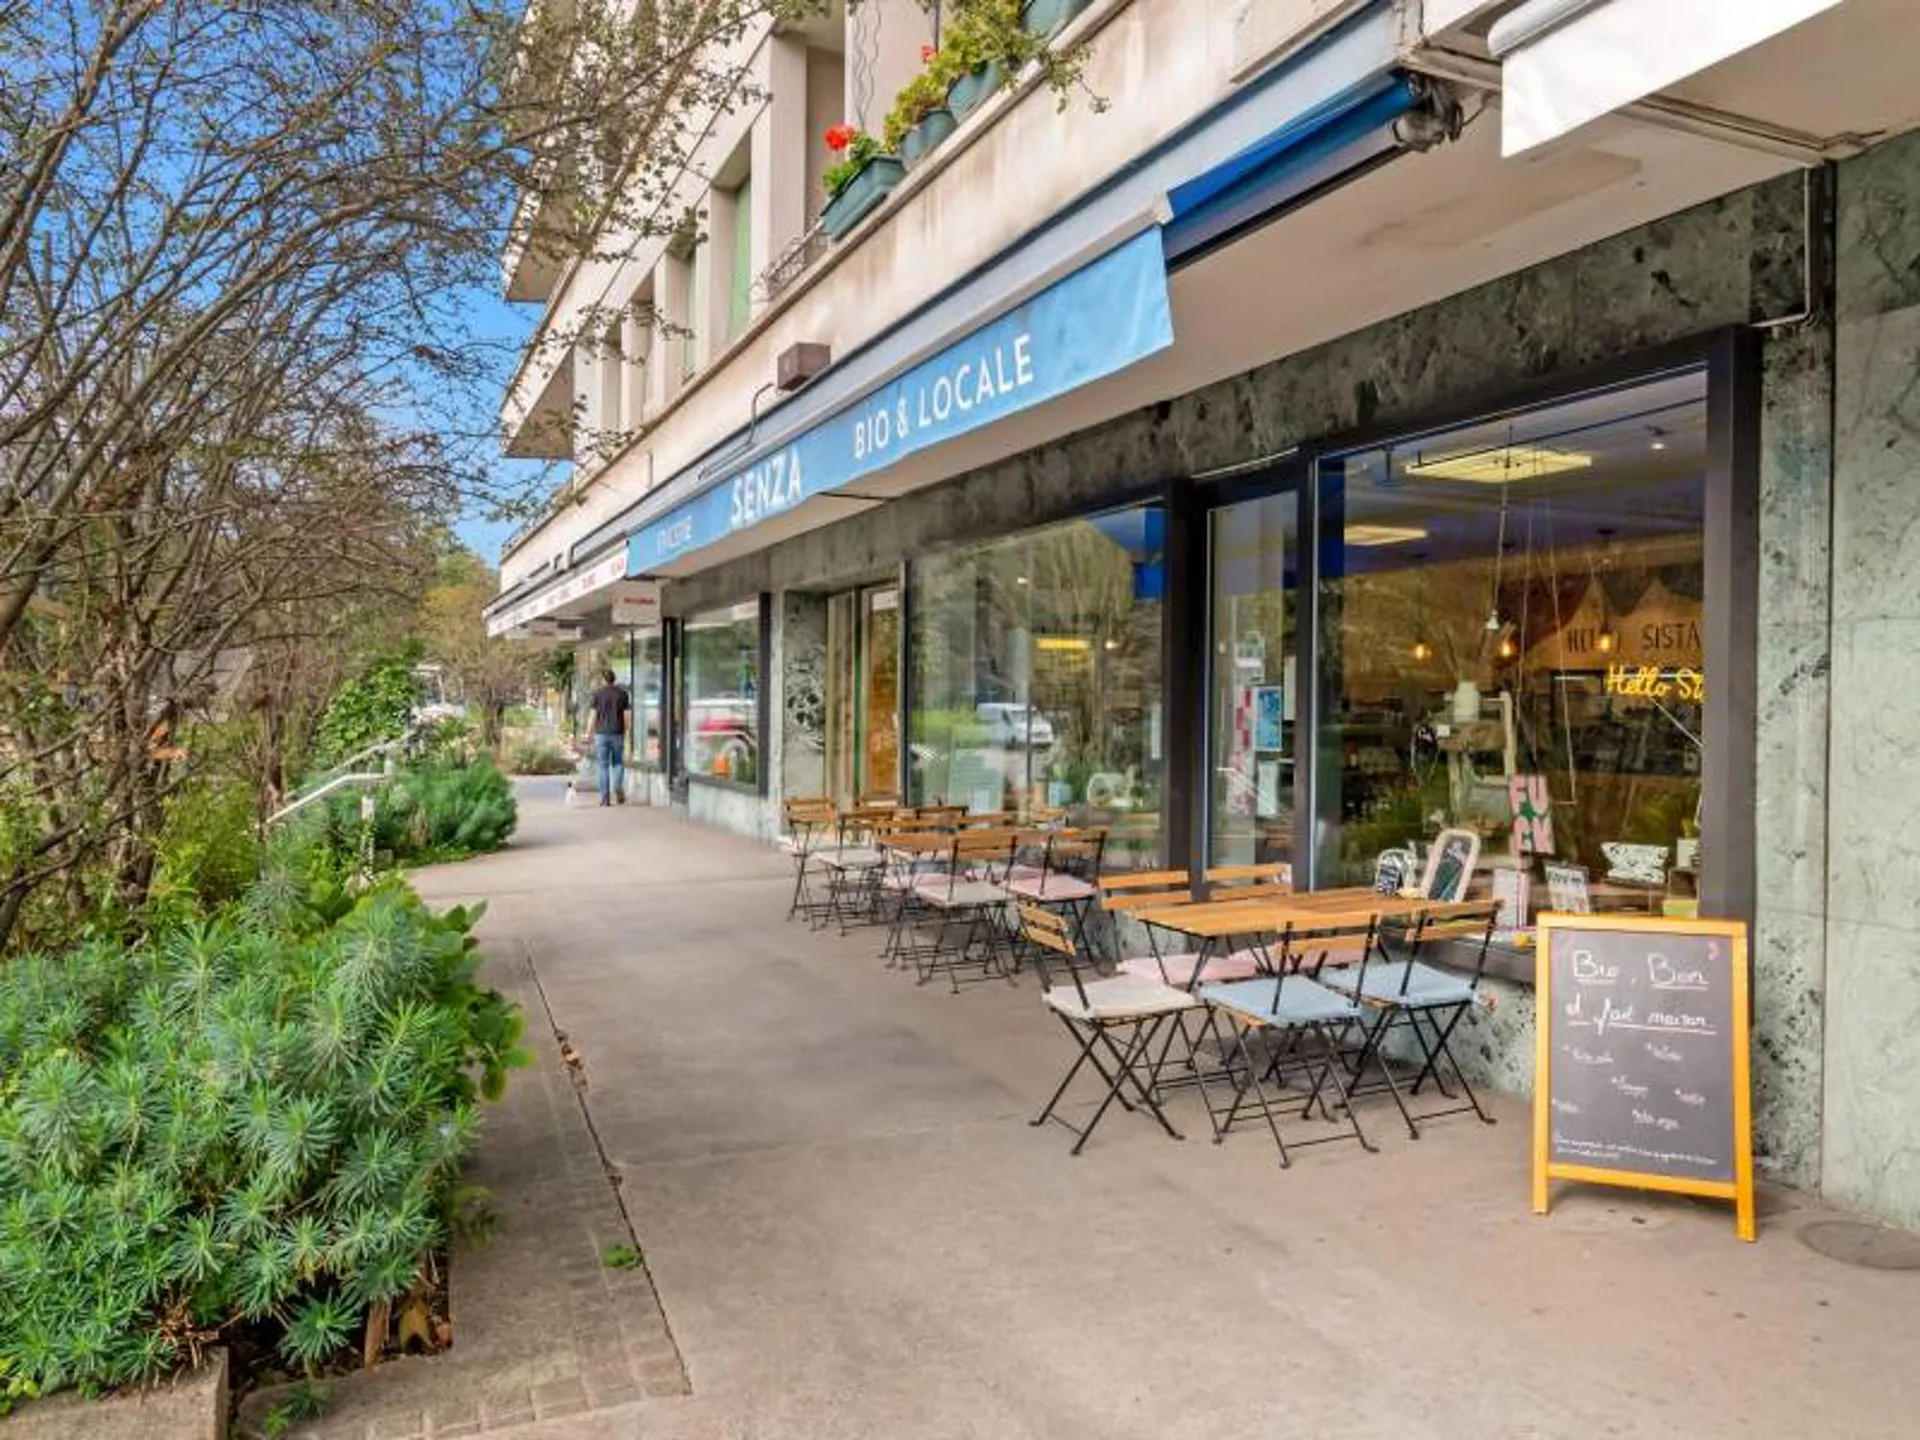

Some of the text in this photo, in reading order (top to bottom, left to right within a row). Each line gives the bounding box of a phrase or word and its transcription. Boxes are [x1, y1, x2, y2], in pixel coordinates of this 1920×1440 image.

[854, 333, 1034, 460] BIO & LOCALE
[730, 444, 802, 529] SENZA
[1642, 620, 1702, 651] SISTA
[1606, 661, 1672, 697] Hello
